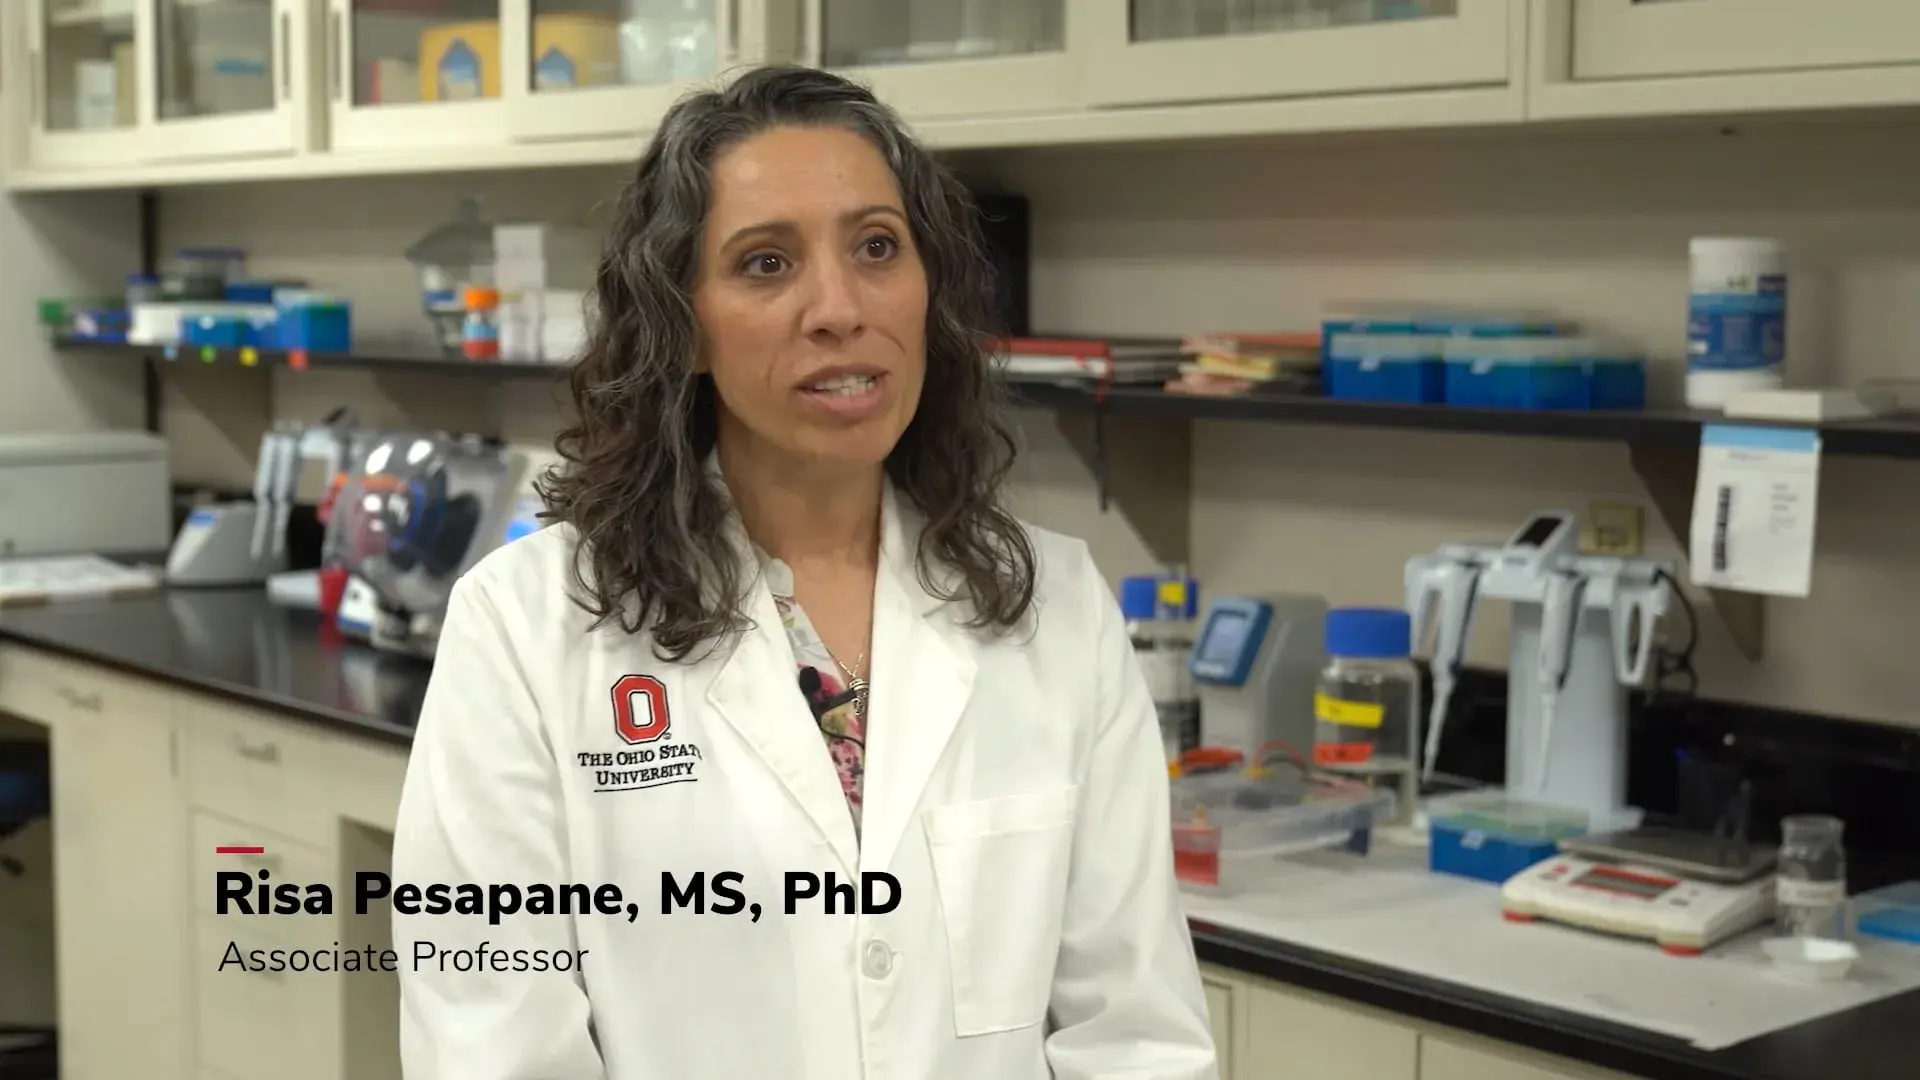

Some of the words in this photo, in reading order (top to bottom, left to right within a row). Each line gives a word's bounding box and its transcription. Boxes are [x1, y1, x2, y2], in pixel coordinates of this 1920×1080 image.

[611, 674, 671, 745] O
[577, 752, 613, 767] THE
[616, 749, 656, 766] OHIO
[659, 743, 703, 760] STAT
[596, 762, 696, 785] UNIVERSITY
